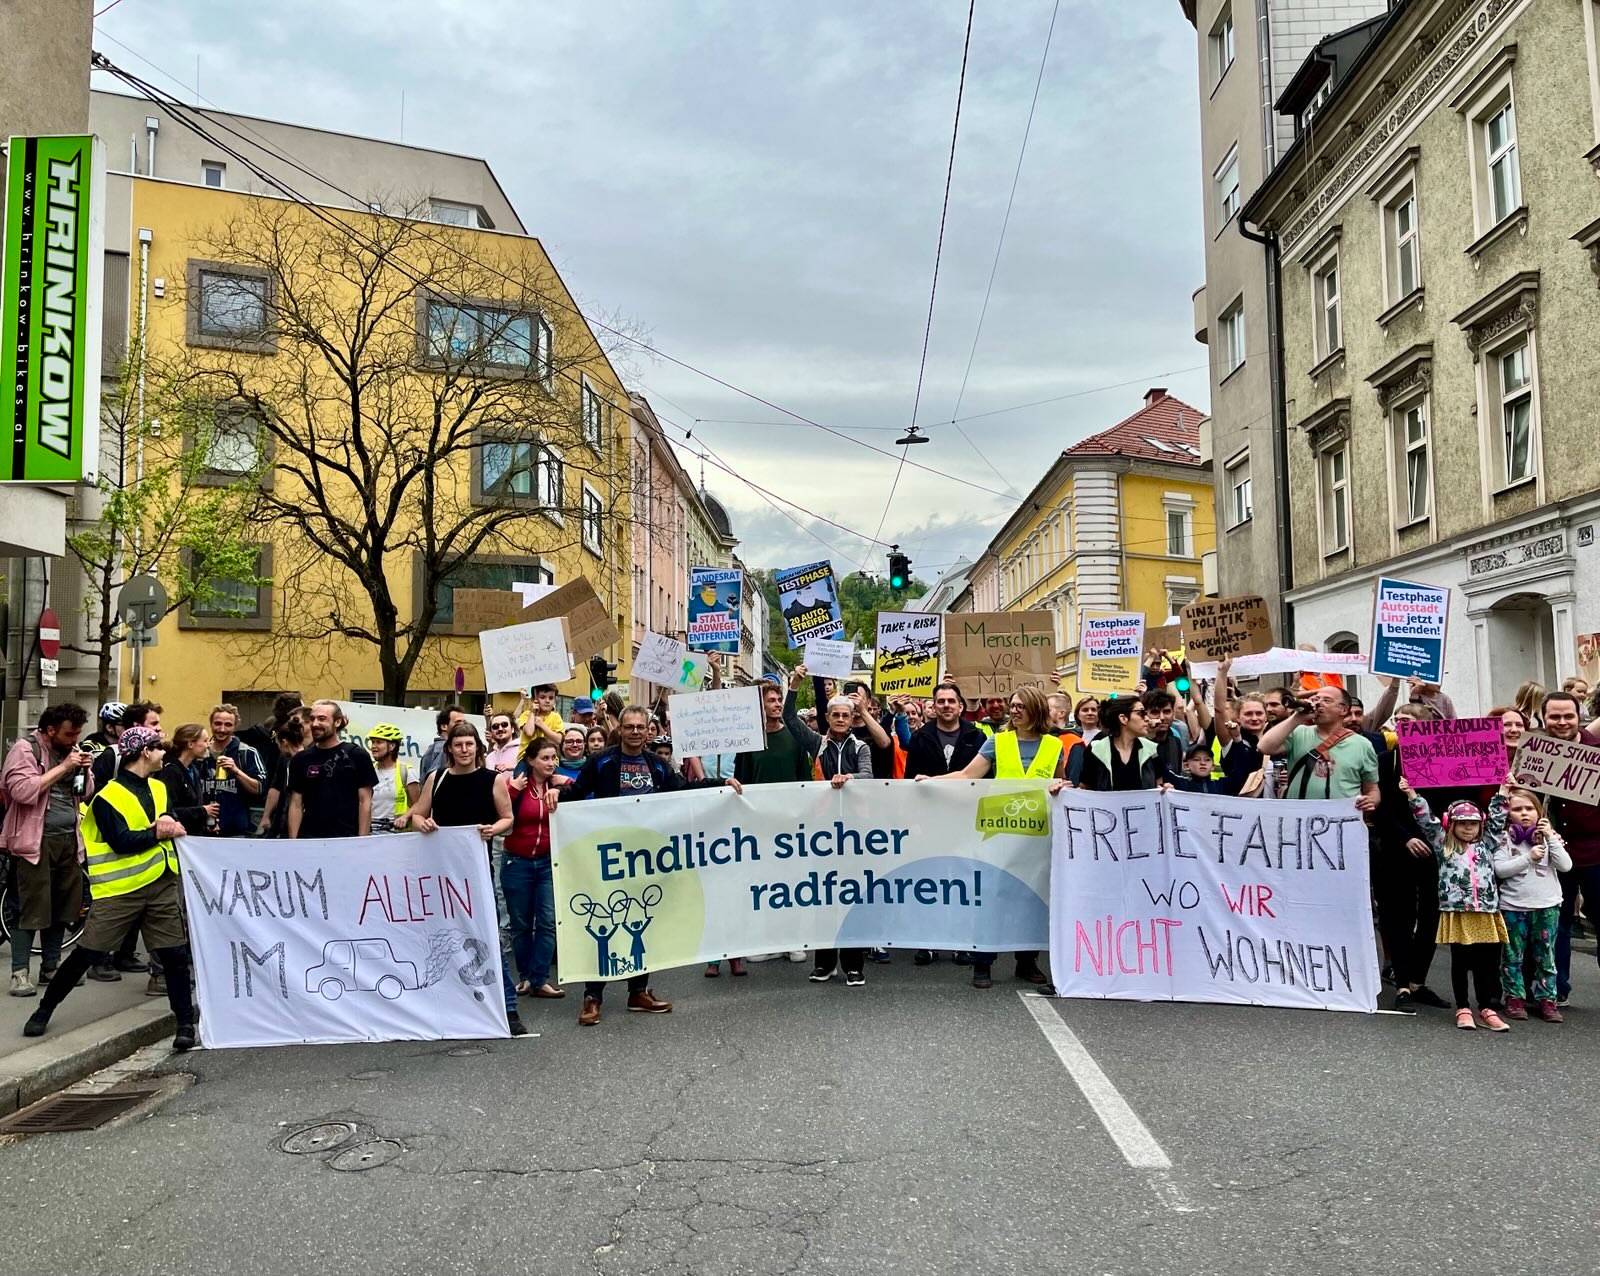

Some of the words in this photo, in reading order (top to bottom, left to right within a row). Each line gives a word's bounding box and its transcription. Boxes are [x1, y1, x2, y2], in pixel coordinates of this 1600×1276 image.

[14, 172, 33, 444] www.hrinkow-bikes.at
[39, 149, 80, 459] HRINKOW
[692, 571, 740, 584] LANDESRAT
[779, 566, 830, 592] TESTPHASE
[1386, 591, 1443, 604] Testphase
[1186, 605, 1215, 618] LINZ
[1219, 597, 1263, 614] MACHT
[1381, 602, 1440, 613] Autostadt
[700, 613, 725, 624] STATT
[789, 617, 800, 627] 20
[801, 608, 828, 622] AUTO-
[791, 614, 830, 633] STREIFEN
[881, 621, 906, 634] TAKE
[913, 617, 937, 630] RISK
[1089, 618, 1140, 630] Testphase
[1192, 612, 1244, 631] POLITIK
[1381, 613, 1405, 623] Linz
[1406, 613, 1433, 625] jetzt
[692, 621, 736, 633] RADWEGE
[796, 620, 843, 644] STOPPEN?
[964, 621, 1051, 648] Menschen
[1085, 628, 1137, 638] Autostadt
[1215, 626, 1229, 637] IM
[1387, 624, 1441, 636] beenden!
[689, 631, 740, 642] ENTFERNEN
[1085, 640, 1106, 648] Linz
[1107, 638, 1131, 648] jetzt
[1090, 646, 1138, 656] beenden!
[1207, 643, 1240, 657] GANG
[989, 653, 1025, 669] VOR
[880, 679, 906, 691] VISIT
[908, 676, 932, 688] LINZ
[1401, 718, 1500, 737] FAHRRADLUST
[1522, 736, 1563, 756] AUTOS
[1522, 762, 1545, 773] SIND
[1526, 756, 1544, 764] UND
[1543, 761, 1600, 799] LAUT!
[980, 816, 1045, 832] radlobby
[1063, 802, 1198, 862] FREIE
[1211, 810, 1361, 870] FAHRT
[597, 825, 761, 881] Endlich
[774, 821, 910, 859] sicher
[188, 868, 328, 920] WARUM
[359, 873, 473, 925] ALLEIN
[750, 869, 983, 912] radfahren!
[1141, 878, 1200, 909] WO
[1221, 883, 1276, 918] WIR
[1198, 925, 1353, 993] WOHNEN
[230, 941, 288, 999] IM
